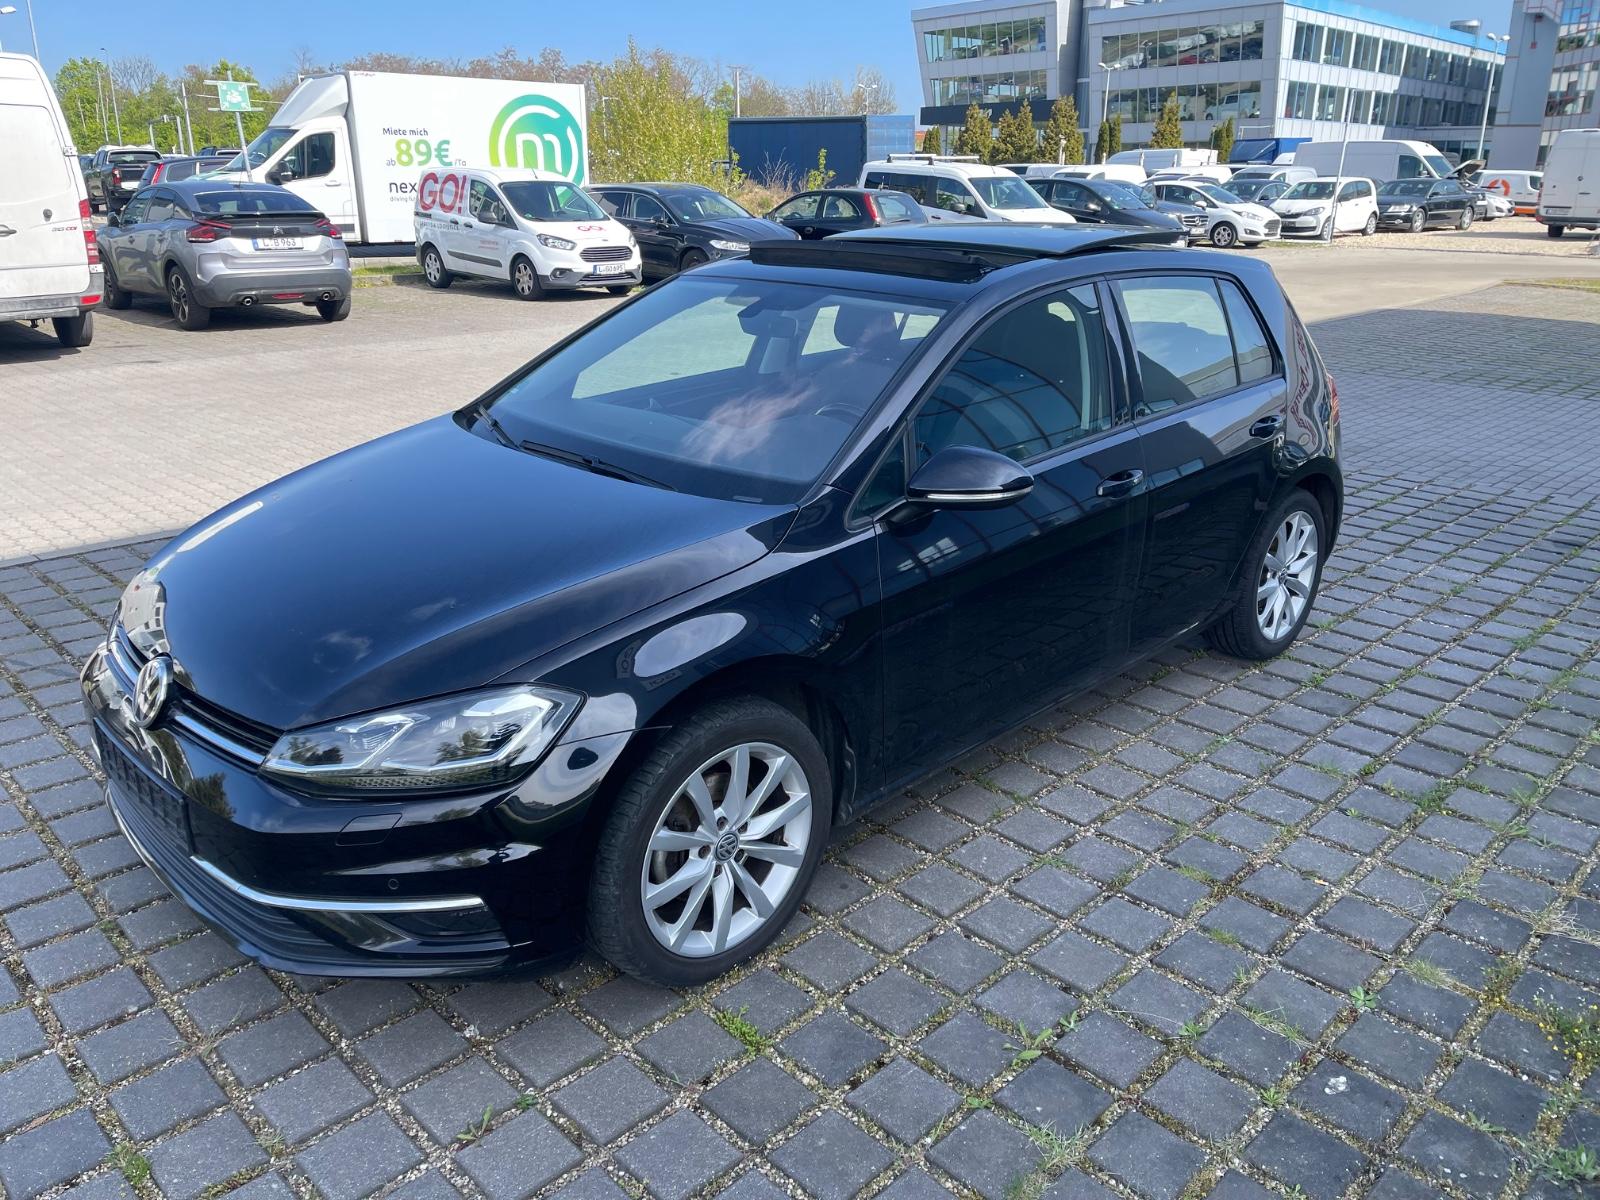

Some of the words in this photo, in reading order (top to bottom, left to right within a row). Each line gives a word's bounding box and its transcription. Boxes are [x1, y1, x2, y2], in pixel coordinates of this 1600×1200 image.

[382, 127, 407, 136] Miete
[409, 128, 429, 136] mich
[386, 157, 396, 166] ab
[395, 138, 453, 167] 89€
[389, 182, 418, 194] nex
[418, 172, 467, 214] GO!
